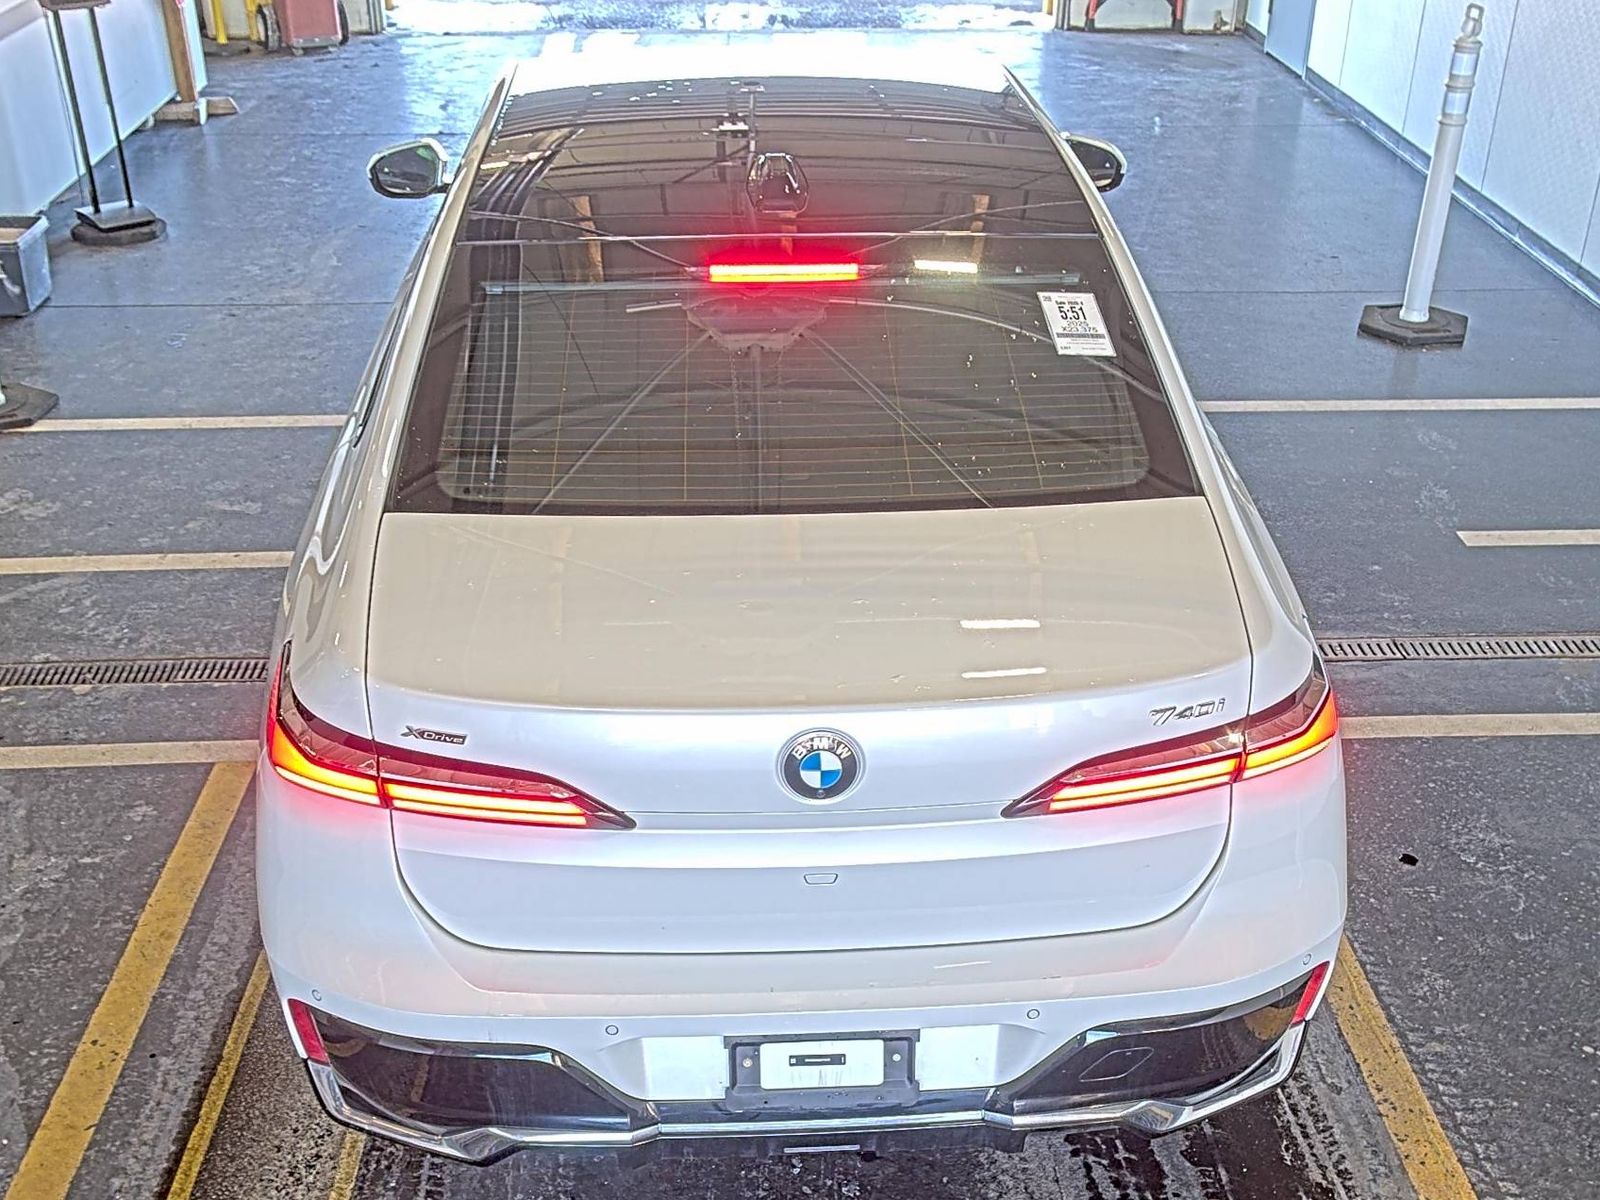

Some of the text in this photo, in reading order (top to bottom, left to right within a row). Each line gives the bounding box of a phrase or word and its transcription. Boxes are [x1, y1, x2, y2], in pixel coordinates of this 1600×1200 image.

[1057, 305, 1087, 320] 5:51
[1149, 697, 1226, 725] 740i
[791, 736, 852, 760] BMW
